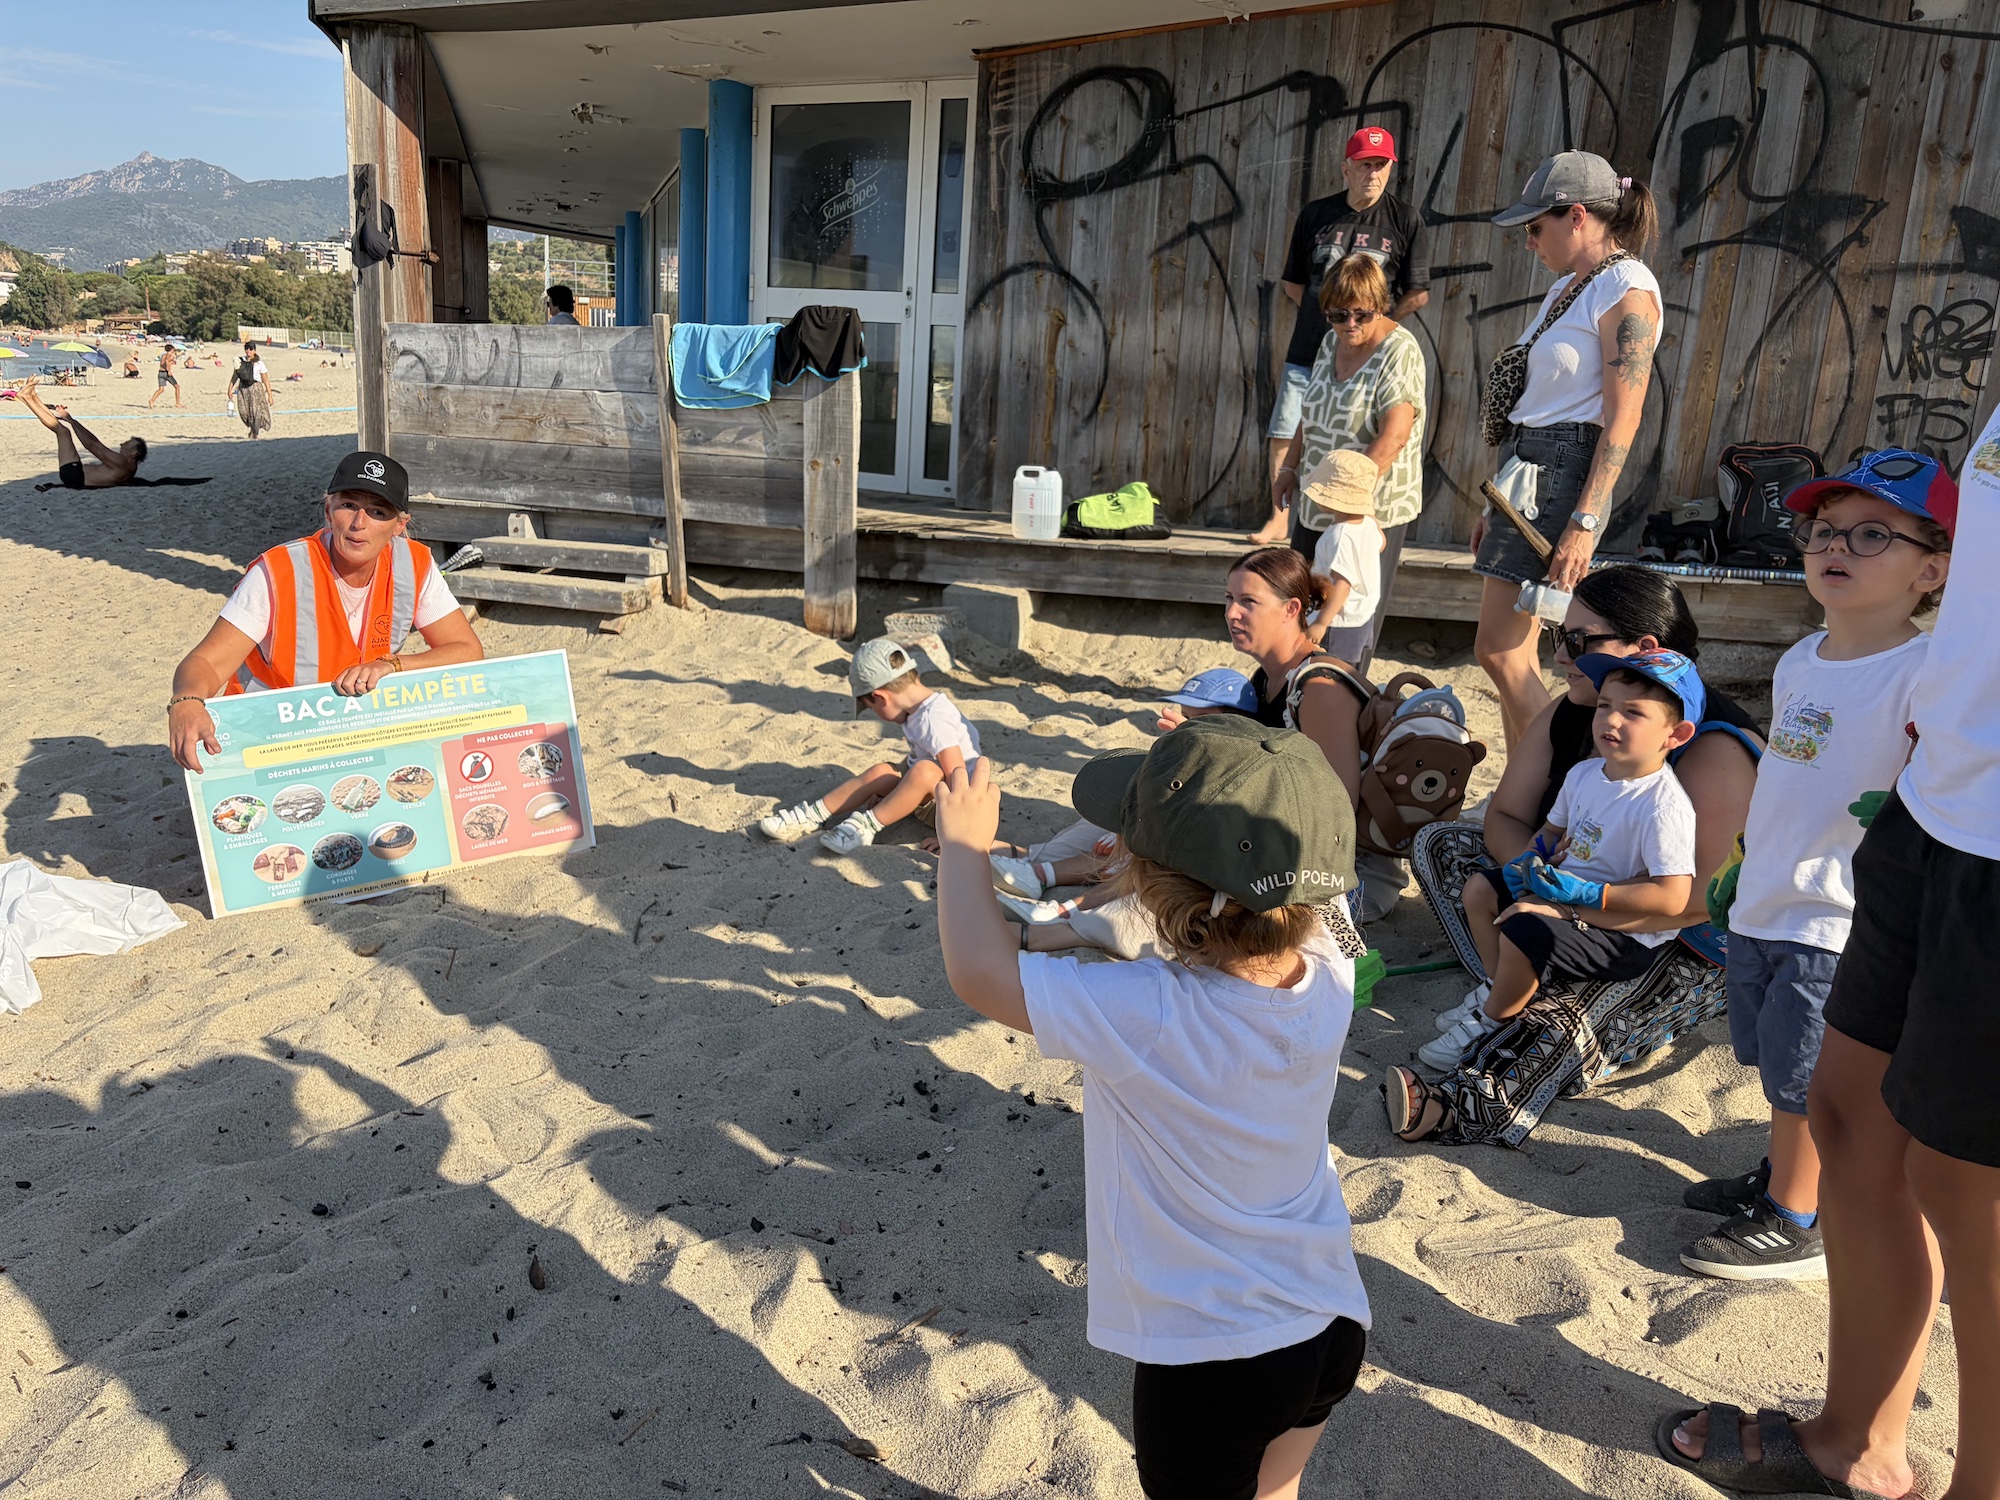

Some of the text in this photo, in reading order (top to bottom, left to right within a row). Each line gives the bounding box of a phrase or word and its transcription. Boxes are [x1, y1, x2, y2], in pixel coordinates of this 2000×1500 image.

[822, 180, 878, 224] Schweppes
[278, 696, 336, 723] BAC
[369, 672, 486, 709] TEMPÊTE
[499, 729, 534, 740] COLLECTER
[268, 766, 300, 778] DÉCHETS
[301, 763, 329, 773] MARINS
[336, 755, 374, 767] COLLECTER
[473, 780, 502, 791] POUBELLES
[455, 786, 508, 800] DÉCHETS MÉNAGERS
[469, 794, 495, 803] INTERDITS
[402, 801, 426, 810] TEXTILES
[350, 812, 369, 820] VERRE
[531, 825, 572, 837] ANIMAUX MORTS
[226, 832, 262, 842] PLASTIQUES
[230, 837, 267, 849] EMBALLAGES
[471, 842, 488, 850] LAISSE
[326, 869, 358, 880] CORDAGES
[268, 880, 301, 891] FERRAILLES
[1250, 870, 1345, 895] WILD POEM
[277, 887, 301, 896] MÉTAUX
[319, 892, 343, 901] SIGNALER
[380, 878, 409, 889] CONTACTER
